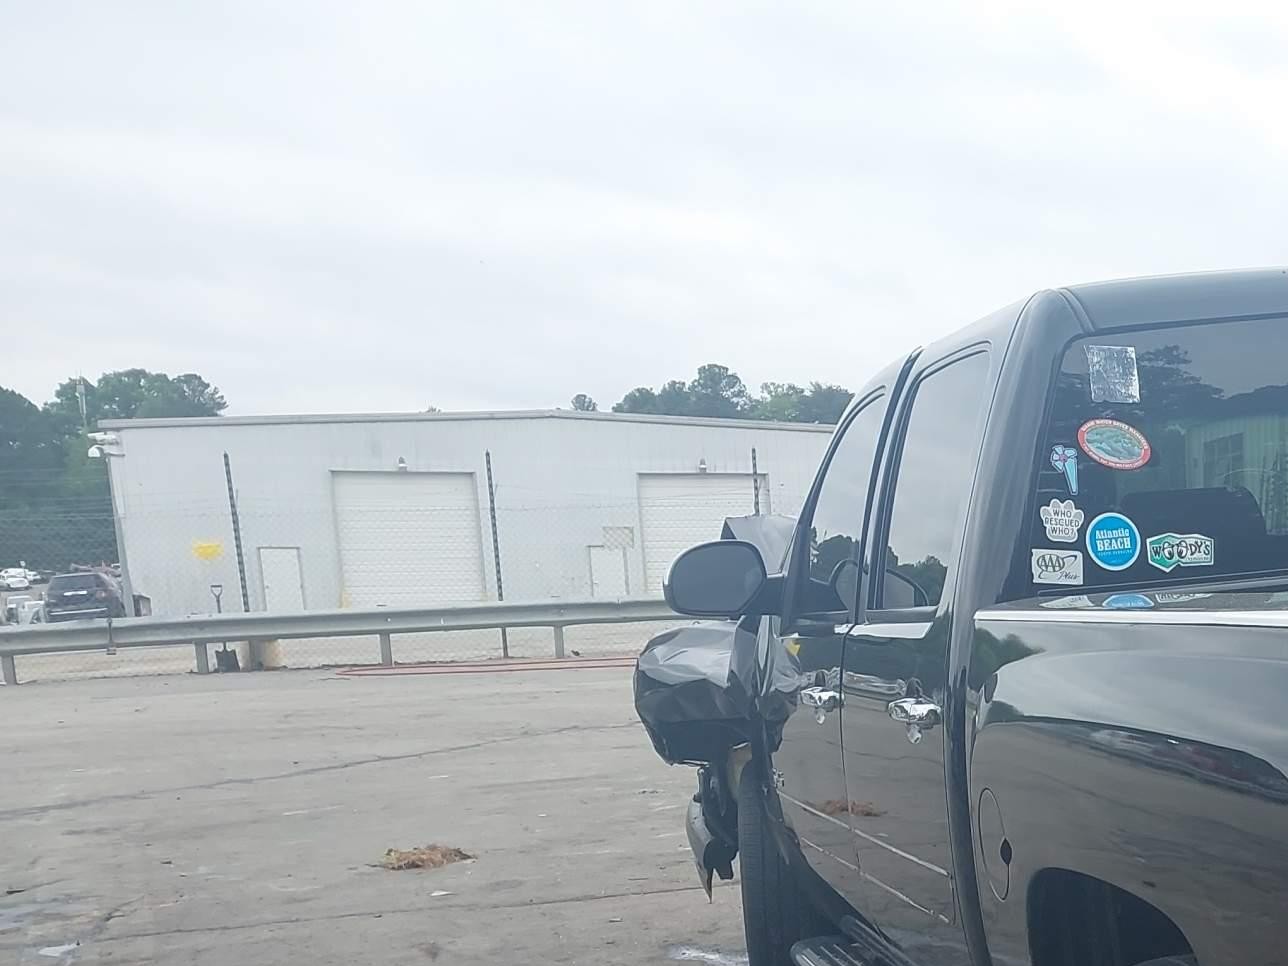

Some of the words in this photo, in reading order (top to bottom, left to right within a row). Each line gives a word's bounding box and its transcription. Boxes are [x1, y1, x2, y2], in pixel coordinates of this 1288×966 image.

[1052, 508, 1072, 519] WHO
[1044, 516, 1080, 528] RESCUED
[1050, 526, 1075, 536] WHO?
[1095, 527, 1130, 540] Atlantic
[1096, 536, 1131, 552] BEACH
[1151, 540, 1211, 561] WOODY'S
[1038, 553, 1065, 573] AAA
[1058, 570, 1080, 581] Plus
